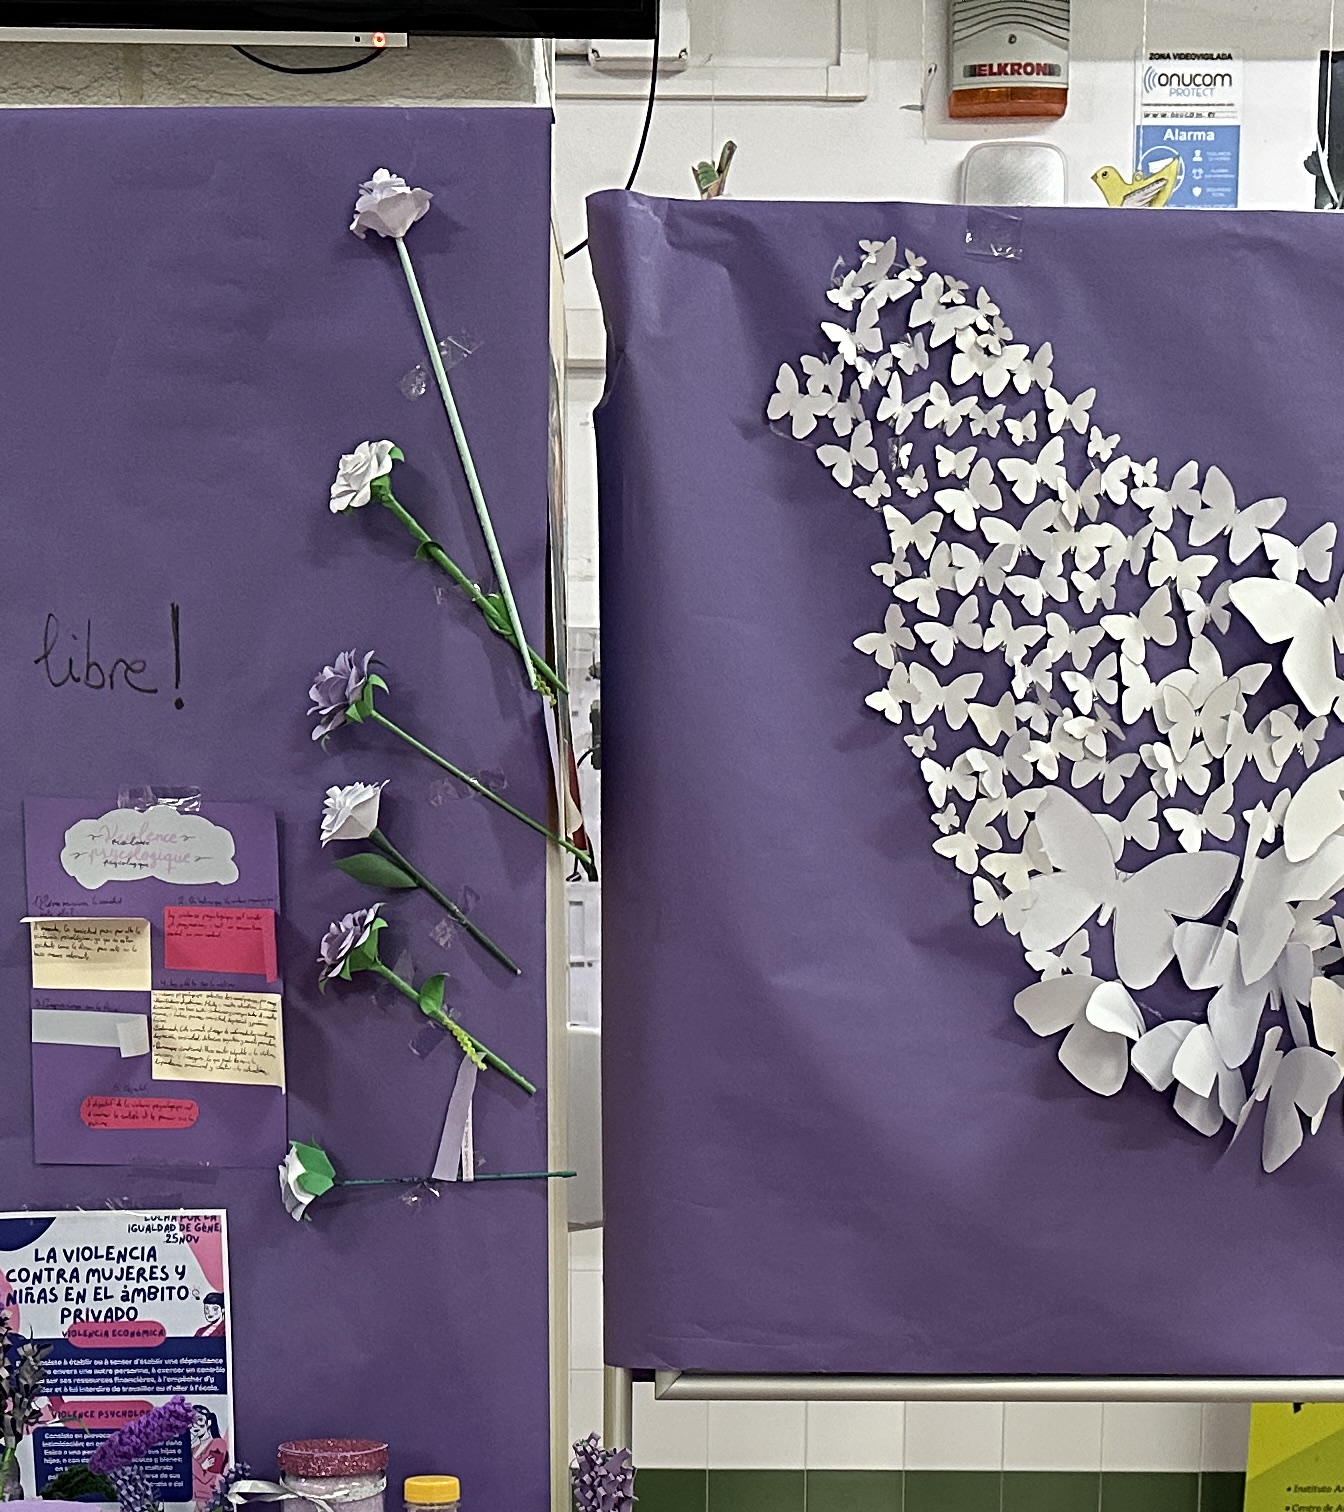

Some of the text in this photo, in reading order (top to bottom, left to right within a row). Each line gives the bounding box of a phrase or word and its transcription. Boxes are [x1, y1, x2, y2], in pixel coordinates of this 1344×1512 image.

[1149, 52, 1233, 61] ZONA VIDEOVIGILADA
[976, 62, 1049, 77] ELKRON
[1157, 72, 1233, 87] onucom
[1169, 87, 1215, 97] PROTECT
[1163, 128, 1215, 142] Alarma
[34, 601, 186, 711] libre!
[128, 1223, 176, 1233] IGUALDAD
[179, 1223, 191, 1233] DE
[34, 1245, 157, 1263] LA VIOLENCIA
[6, 1267, 79, 1285] CONTRA
[85, 1265, 169, 1284] MUJERES
[65, 1288, 87, 1304] EN
[93, 1286, 116, 1301] EL
[60, 1306, 139, 1324] PRIVADO
[62, 1328, 109, 1338] VIOLENCIA
[52, 1410, 96, 1420] VIOLENCE
